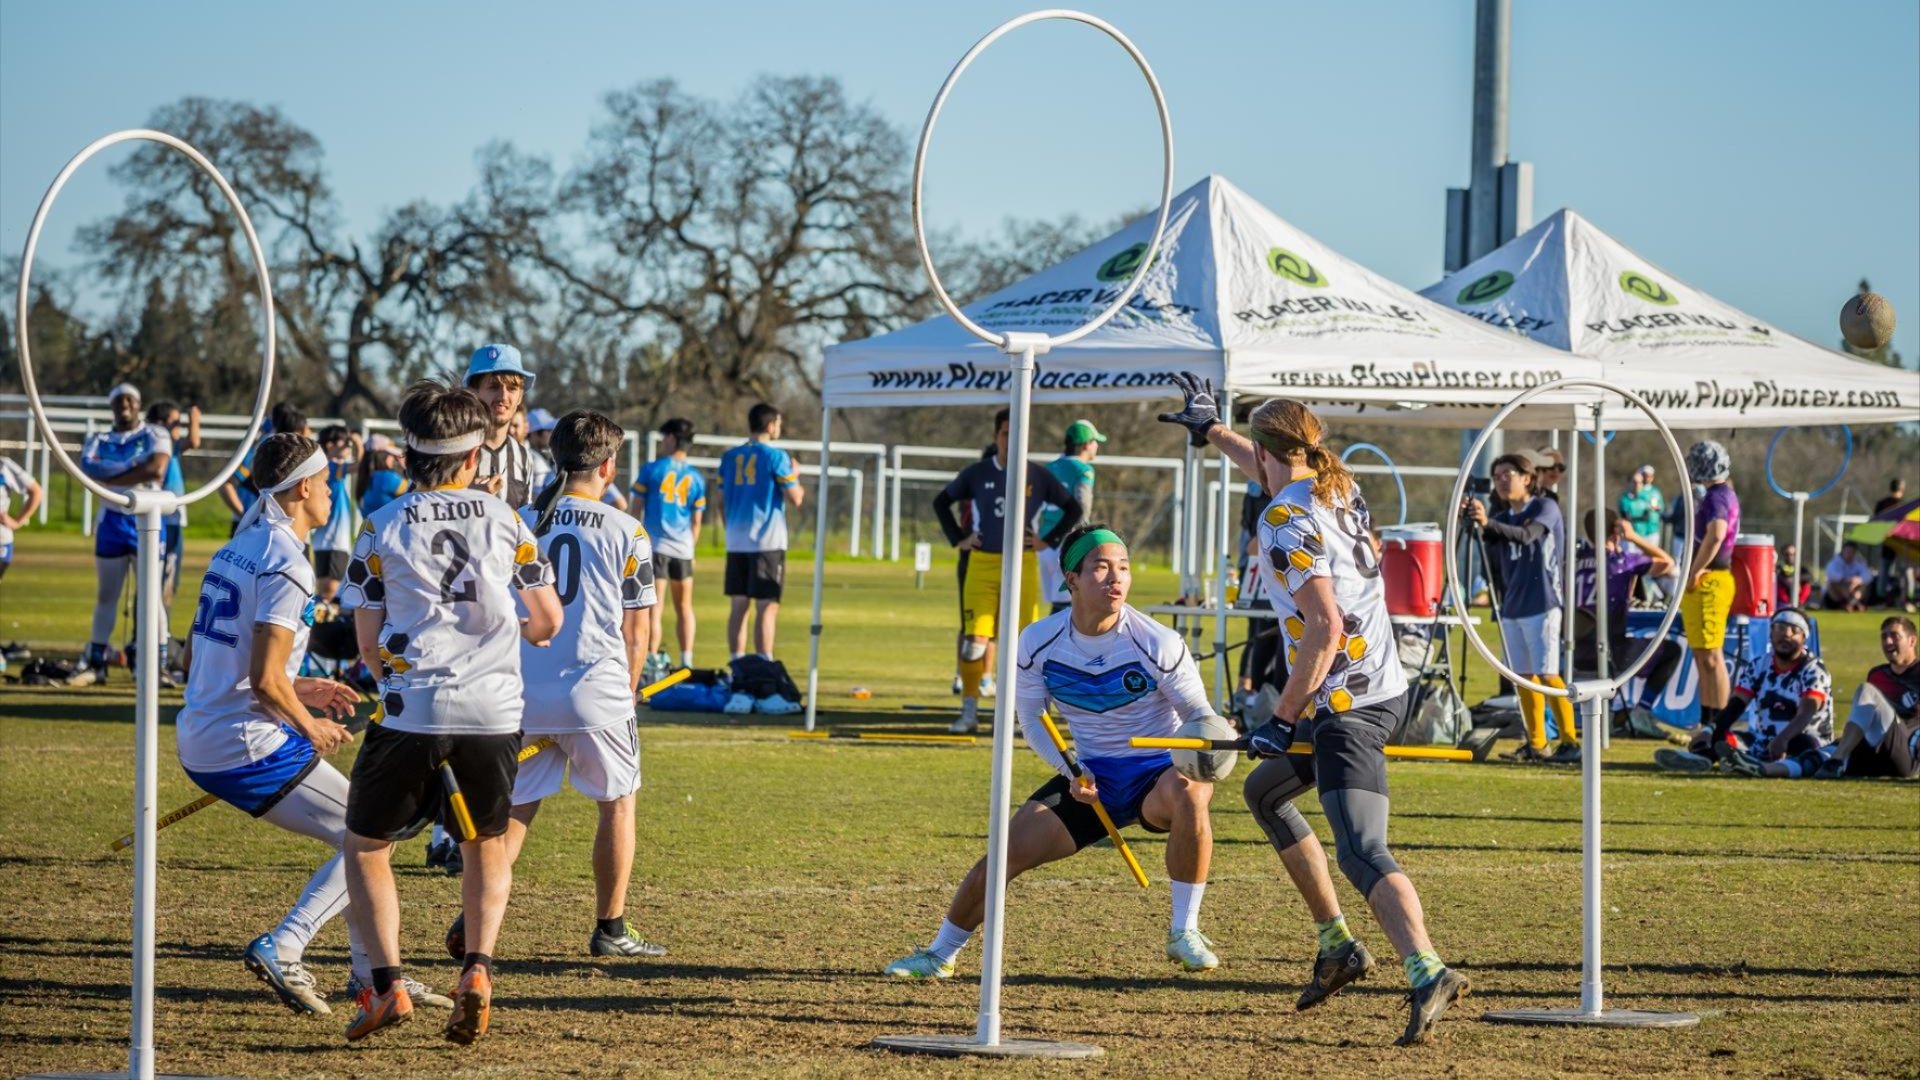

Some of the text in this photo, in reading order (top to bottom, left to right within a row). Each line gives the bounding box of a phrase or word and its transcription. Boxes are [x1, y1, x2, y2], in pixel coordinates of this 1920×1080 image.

[1234, 296, 1336, 322] PLACER
[1586, 312, 1685, 334] PLACER
[868, 361, 1173, 391] www.Playlacer.com
[735, 454, 757, 485] 14
[659, 471, 693, 507] 44
[404, 500, 485, 525] N. LIOU
[538, 509, 605, 529] ROWN
[1336, 507, 1379, 579] 8
[431, 529, 477, 604] 2
